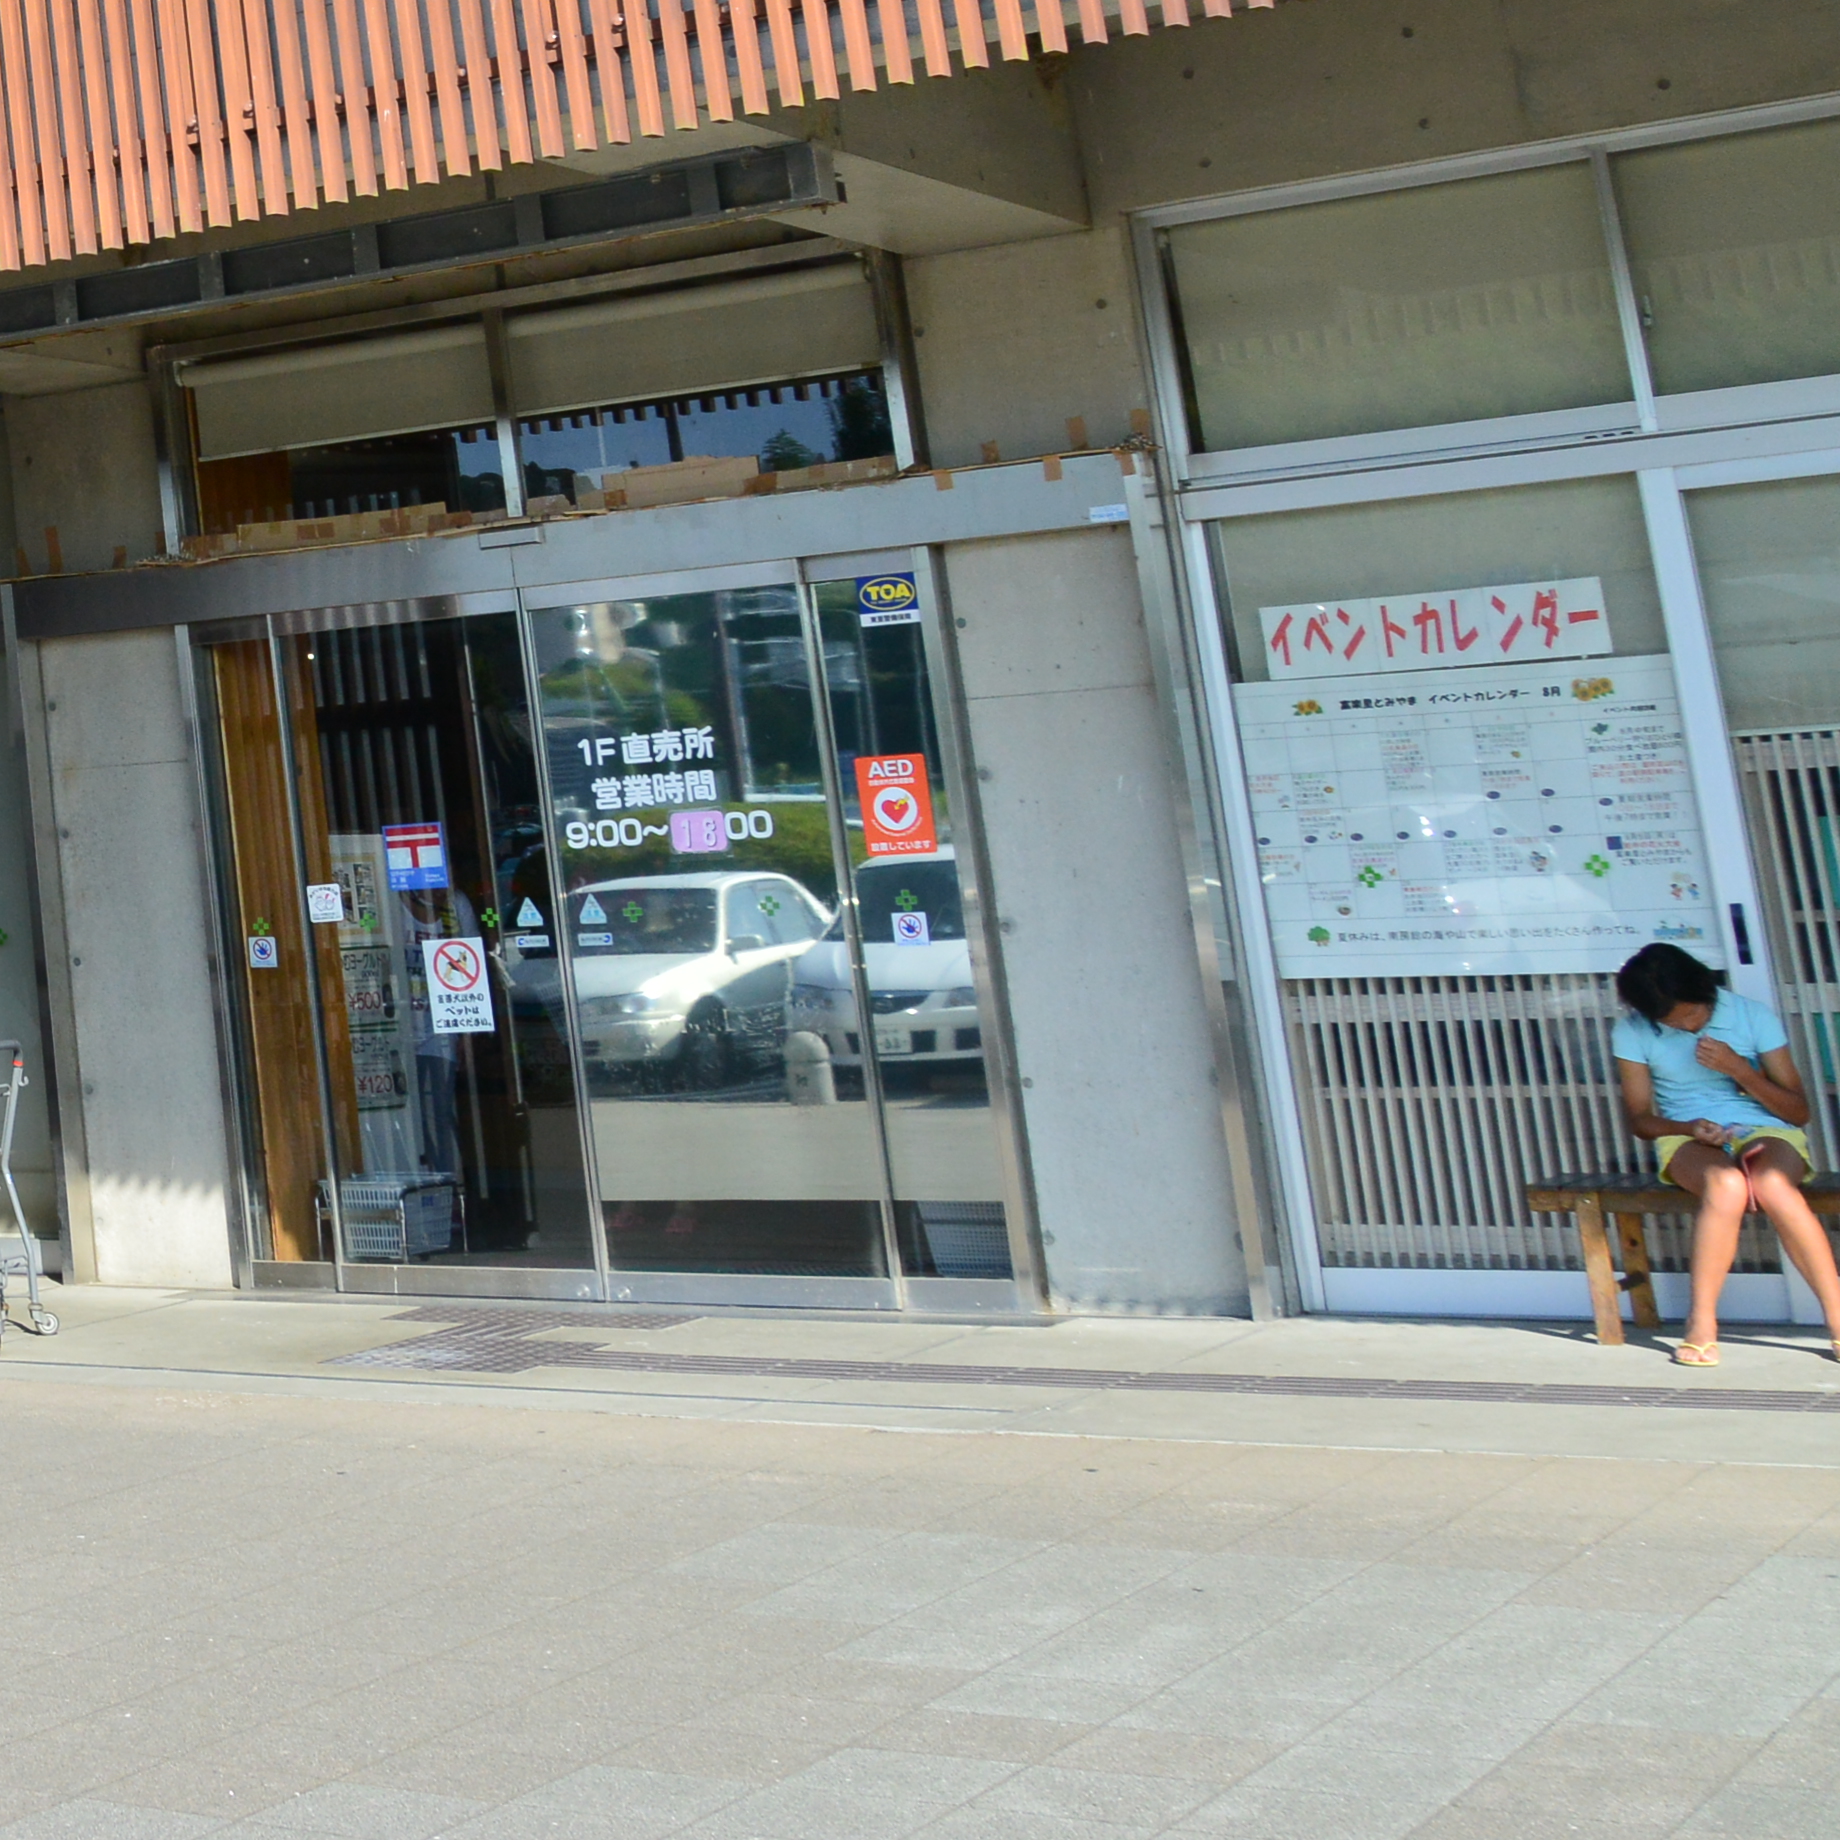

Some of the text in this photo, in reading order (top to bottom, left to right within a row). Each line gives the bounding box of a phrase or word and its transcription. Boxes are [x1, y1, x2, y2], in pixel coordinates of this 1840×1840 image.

[866, 583, 912, 601] TOA
[1270, 588, 1600, 666] イベントカレンダー
[1428, 688, 1531, 705] イベントカレンダー
[868, 759, 914, 778] AED
[591, 769, 717, 811] 営業時間
